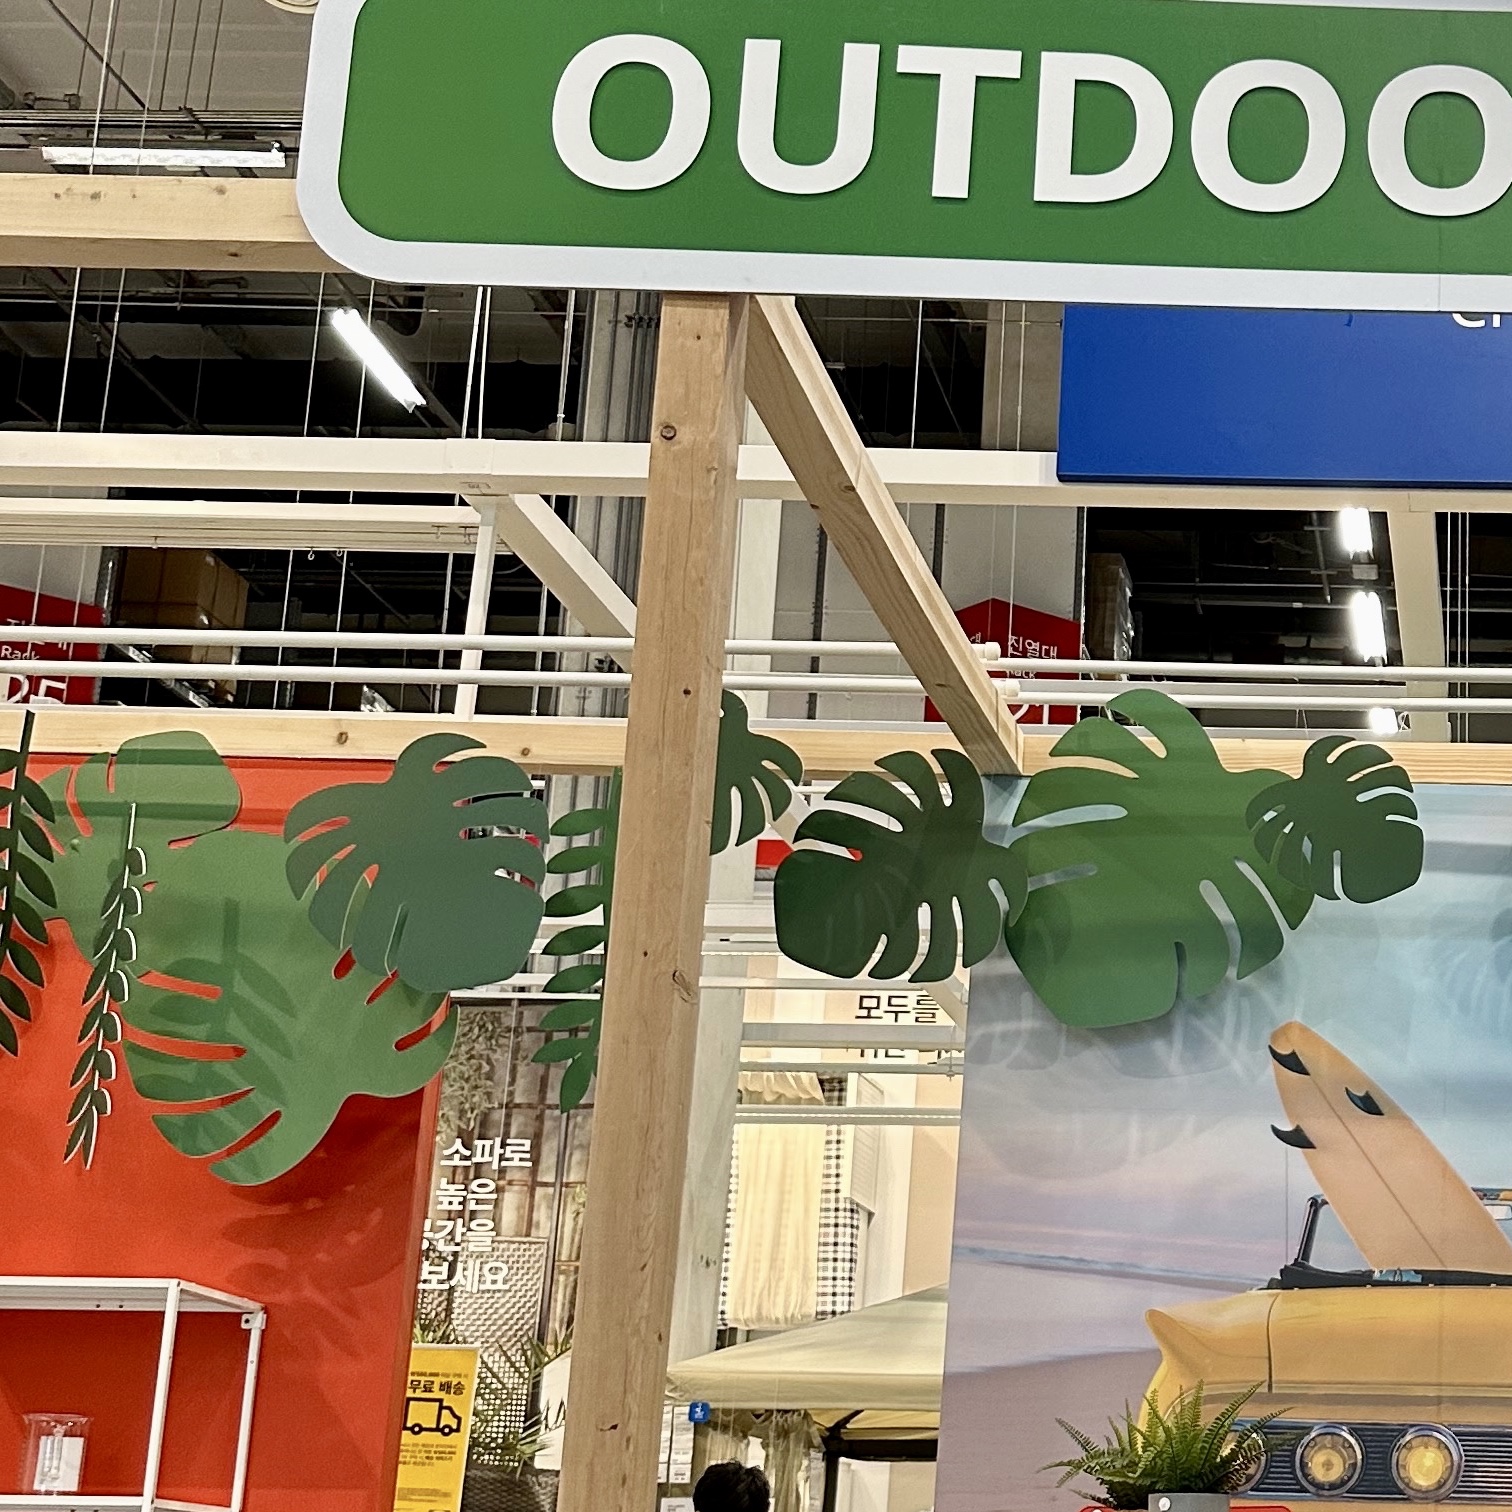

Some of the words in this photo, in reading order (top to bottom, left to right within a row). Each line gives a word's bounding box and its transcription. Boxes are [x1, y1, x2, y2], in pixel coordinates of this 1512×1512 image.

[854, 994, 940, 1024] 모두를
[440, 1137, 533, 1171] 소파로
[435, 1177, 498, 1211] 높은
[417, 1259, 510, 1294] 보세요
[408, 1379, 435, 1394] 무료
[439, 1380, 466, 1396] 배송
